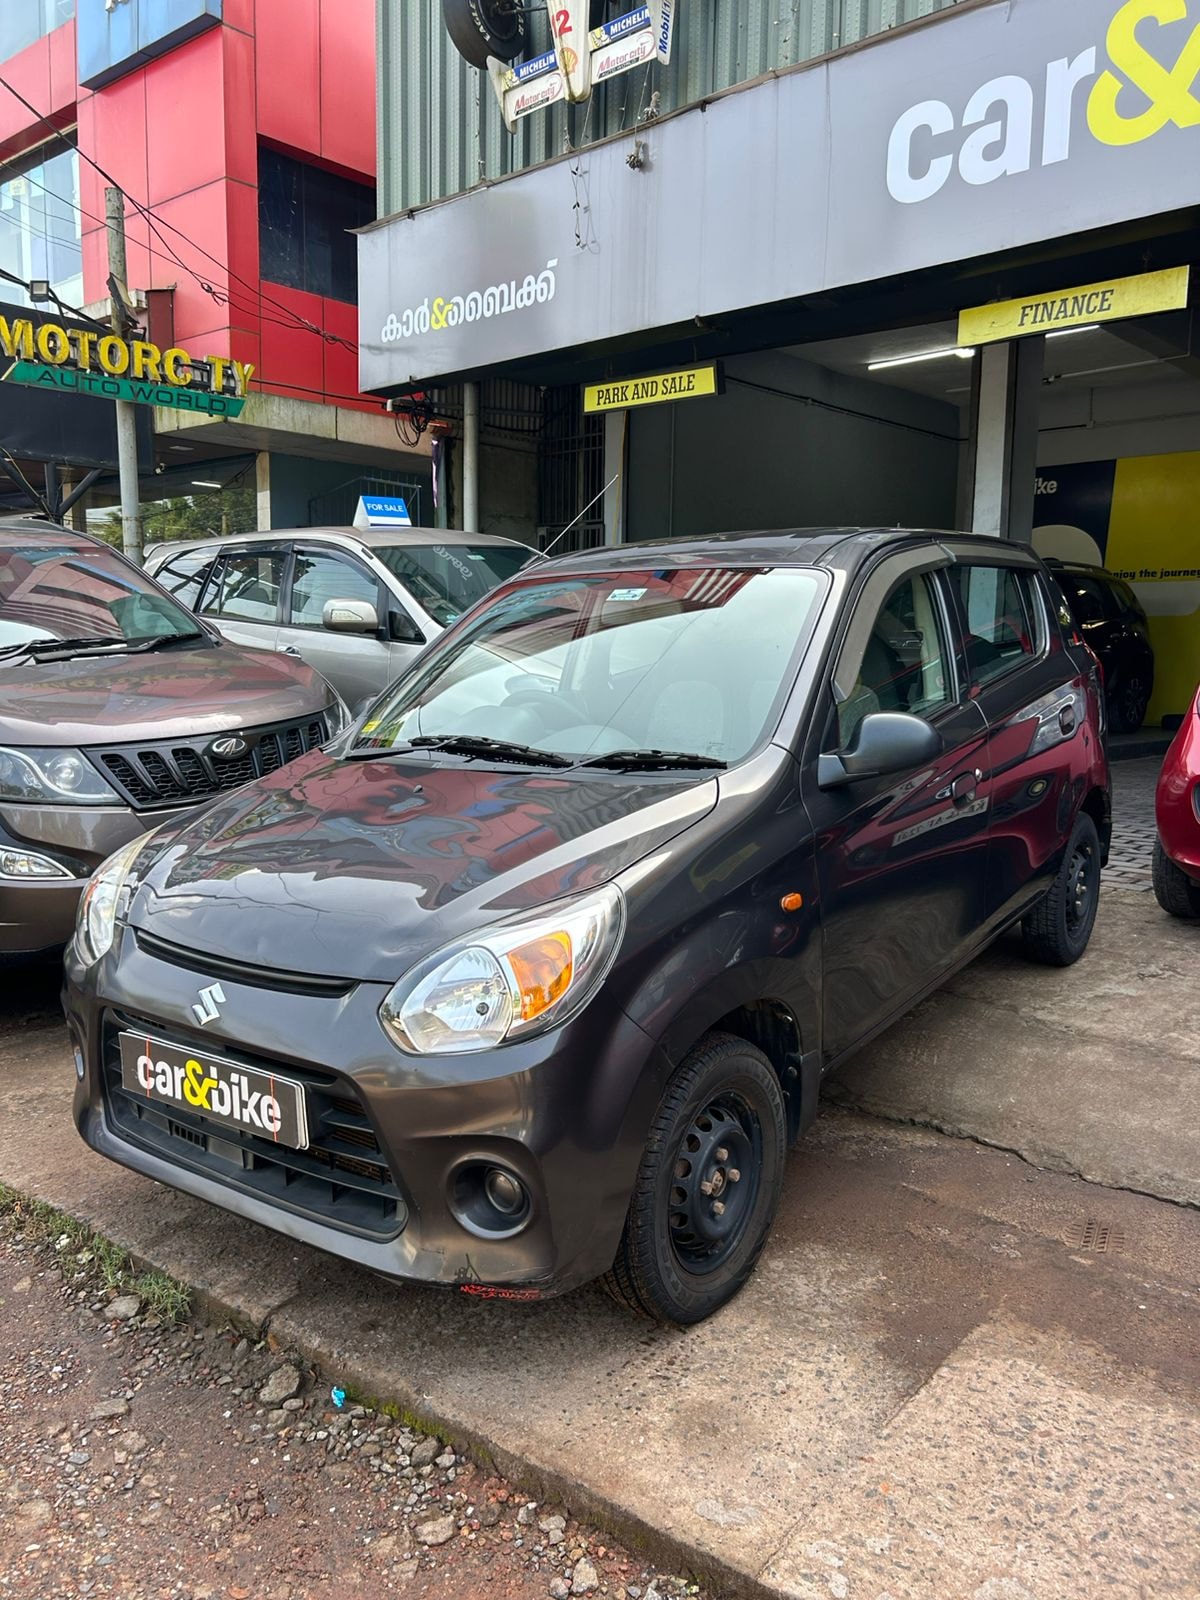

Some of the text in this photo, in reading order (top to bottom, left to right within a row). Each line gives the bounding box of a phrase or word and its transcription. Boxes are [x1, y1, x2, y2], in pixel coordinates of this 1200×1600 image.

[1018, 289, 1114, 327] FINANCE
[38, 370, 227, 413] AUTO WORLD
[596, 373, 695, 406] PARK AND SALE
[366, 502, 405, 513] FOR SALE
[1110, 569, 1136, 581] njoy
[1138, 568, 1158, 578] the
[136, 1054, 282, 1133] car&bike
